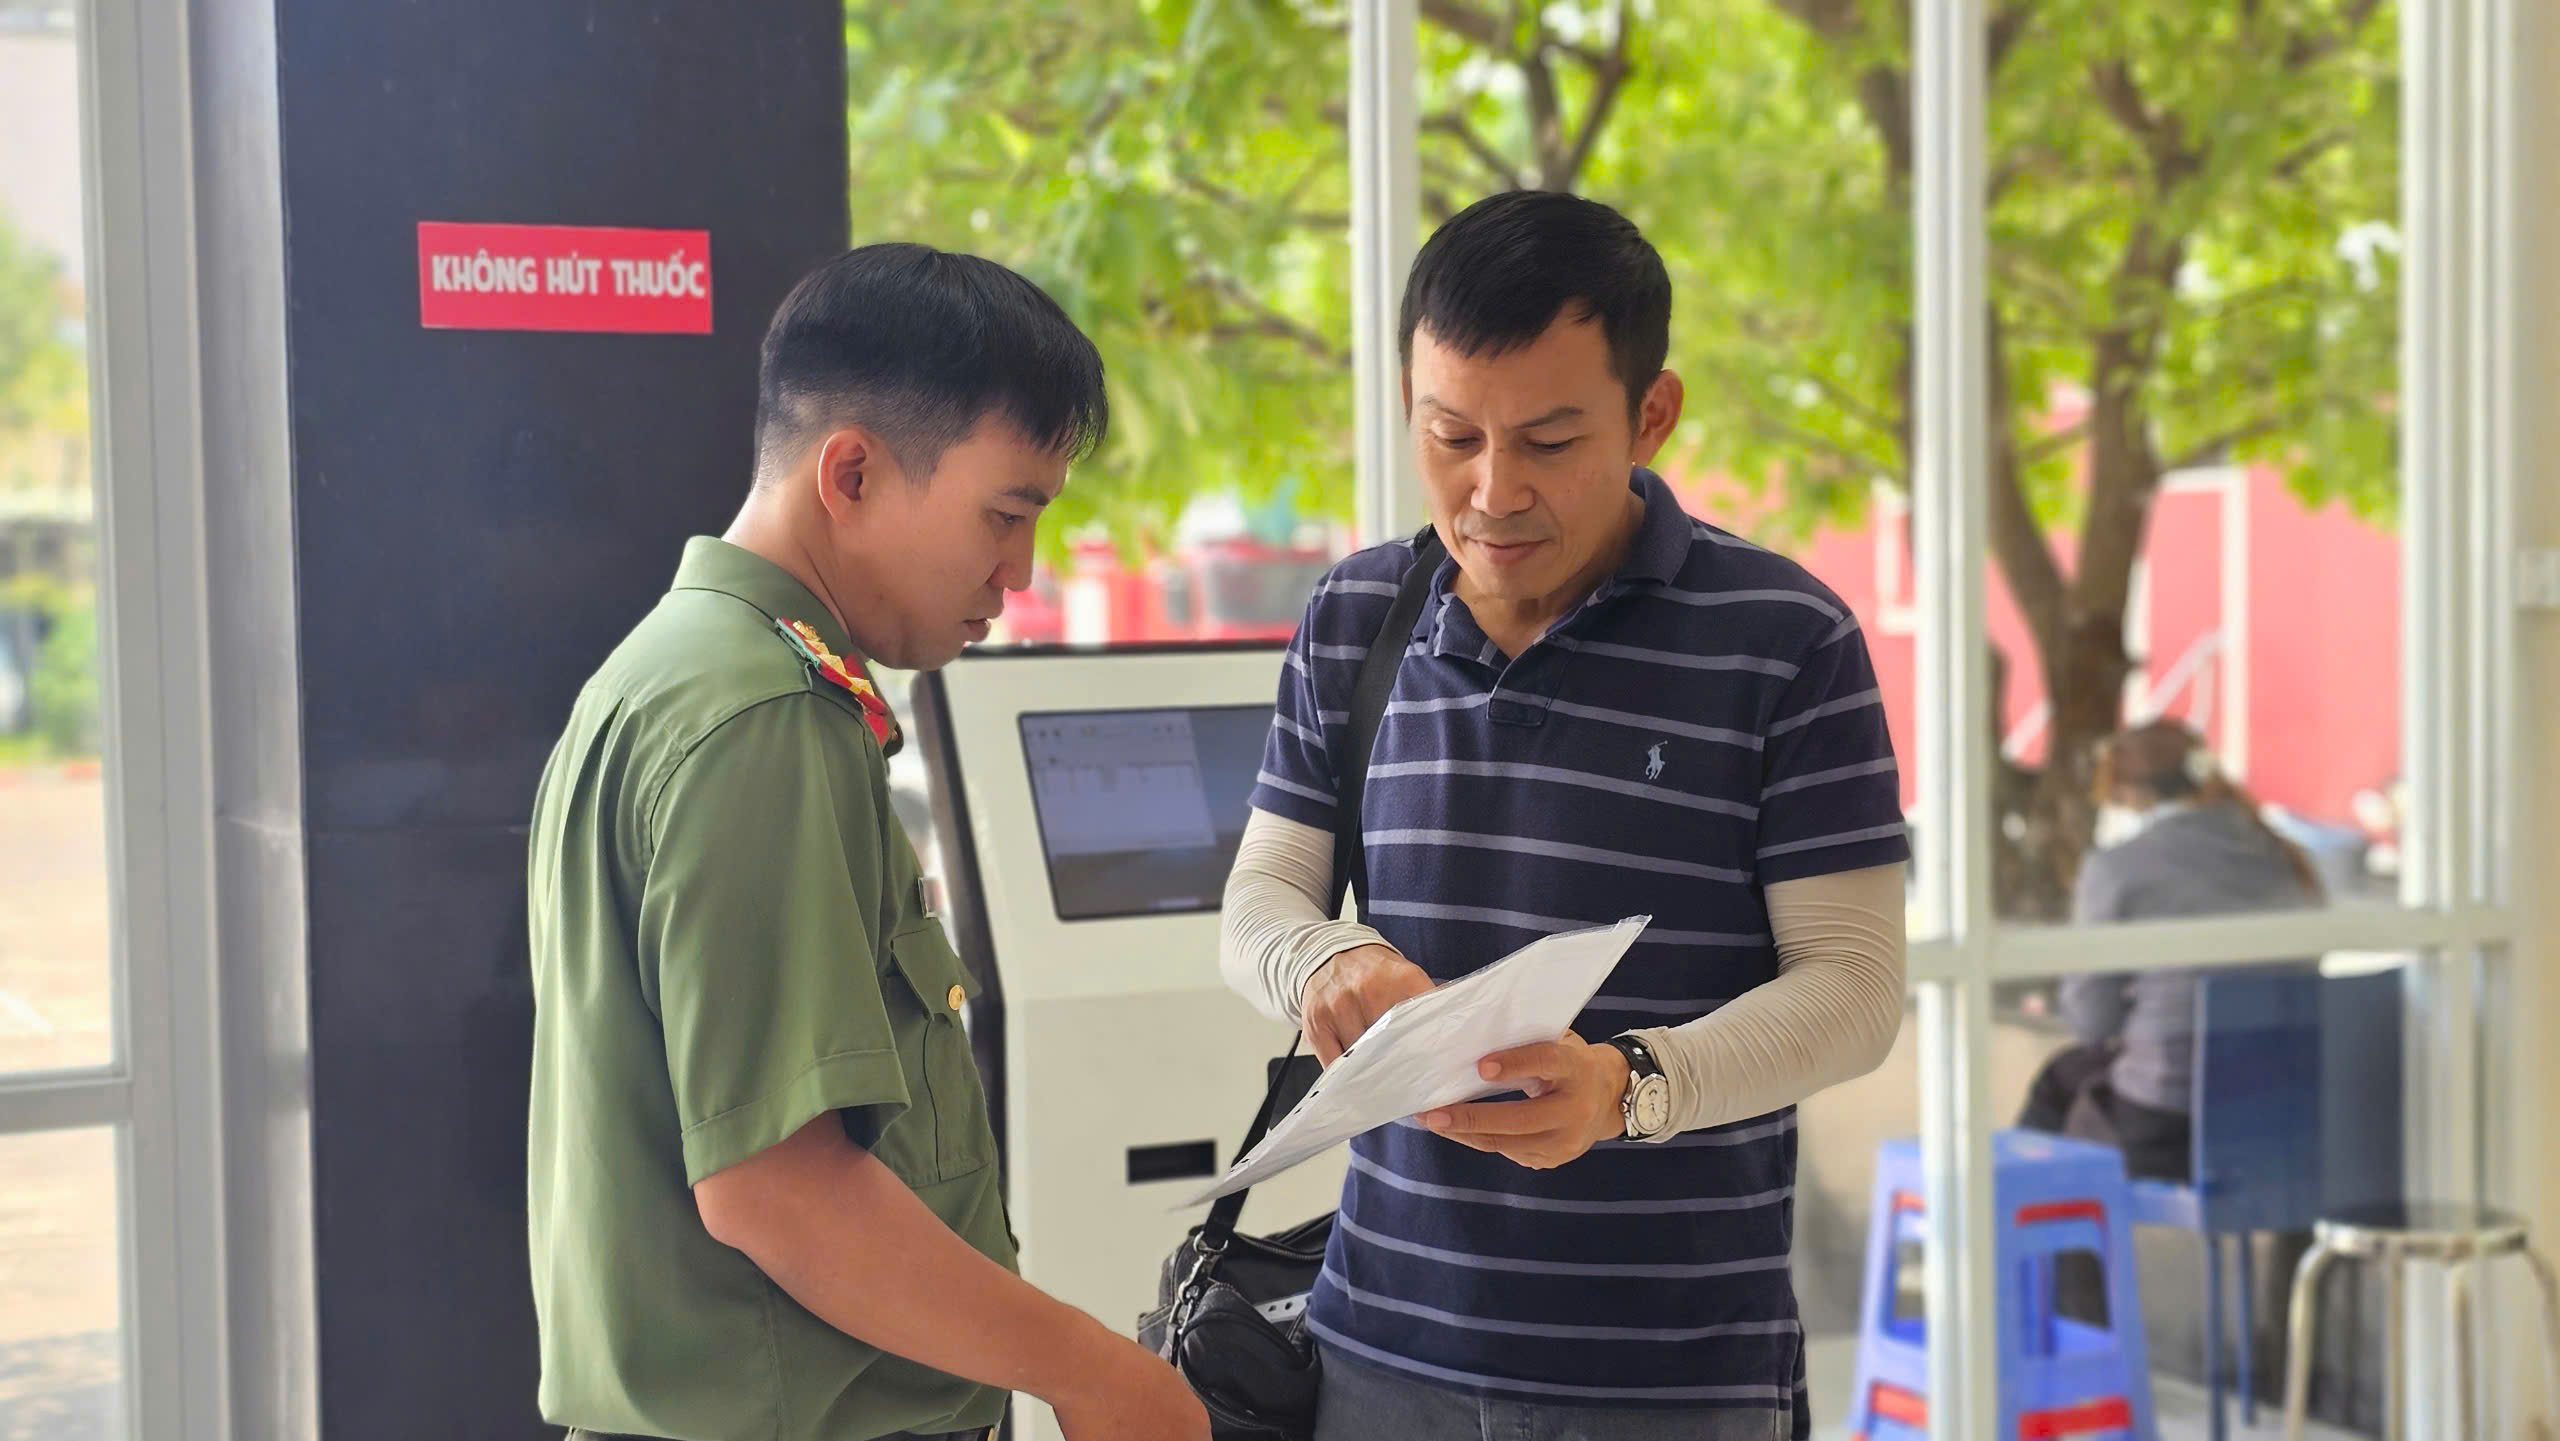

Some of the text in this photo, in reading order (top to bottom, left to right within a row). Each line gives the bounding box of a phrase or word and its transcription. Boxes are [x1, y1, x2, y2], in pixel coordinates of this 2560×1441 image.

[431, 248, 706, 297] KHÔNG HÚT THUỐC
